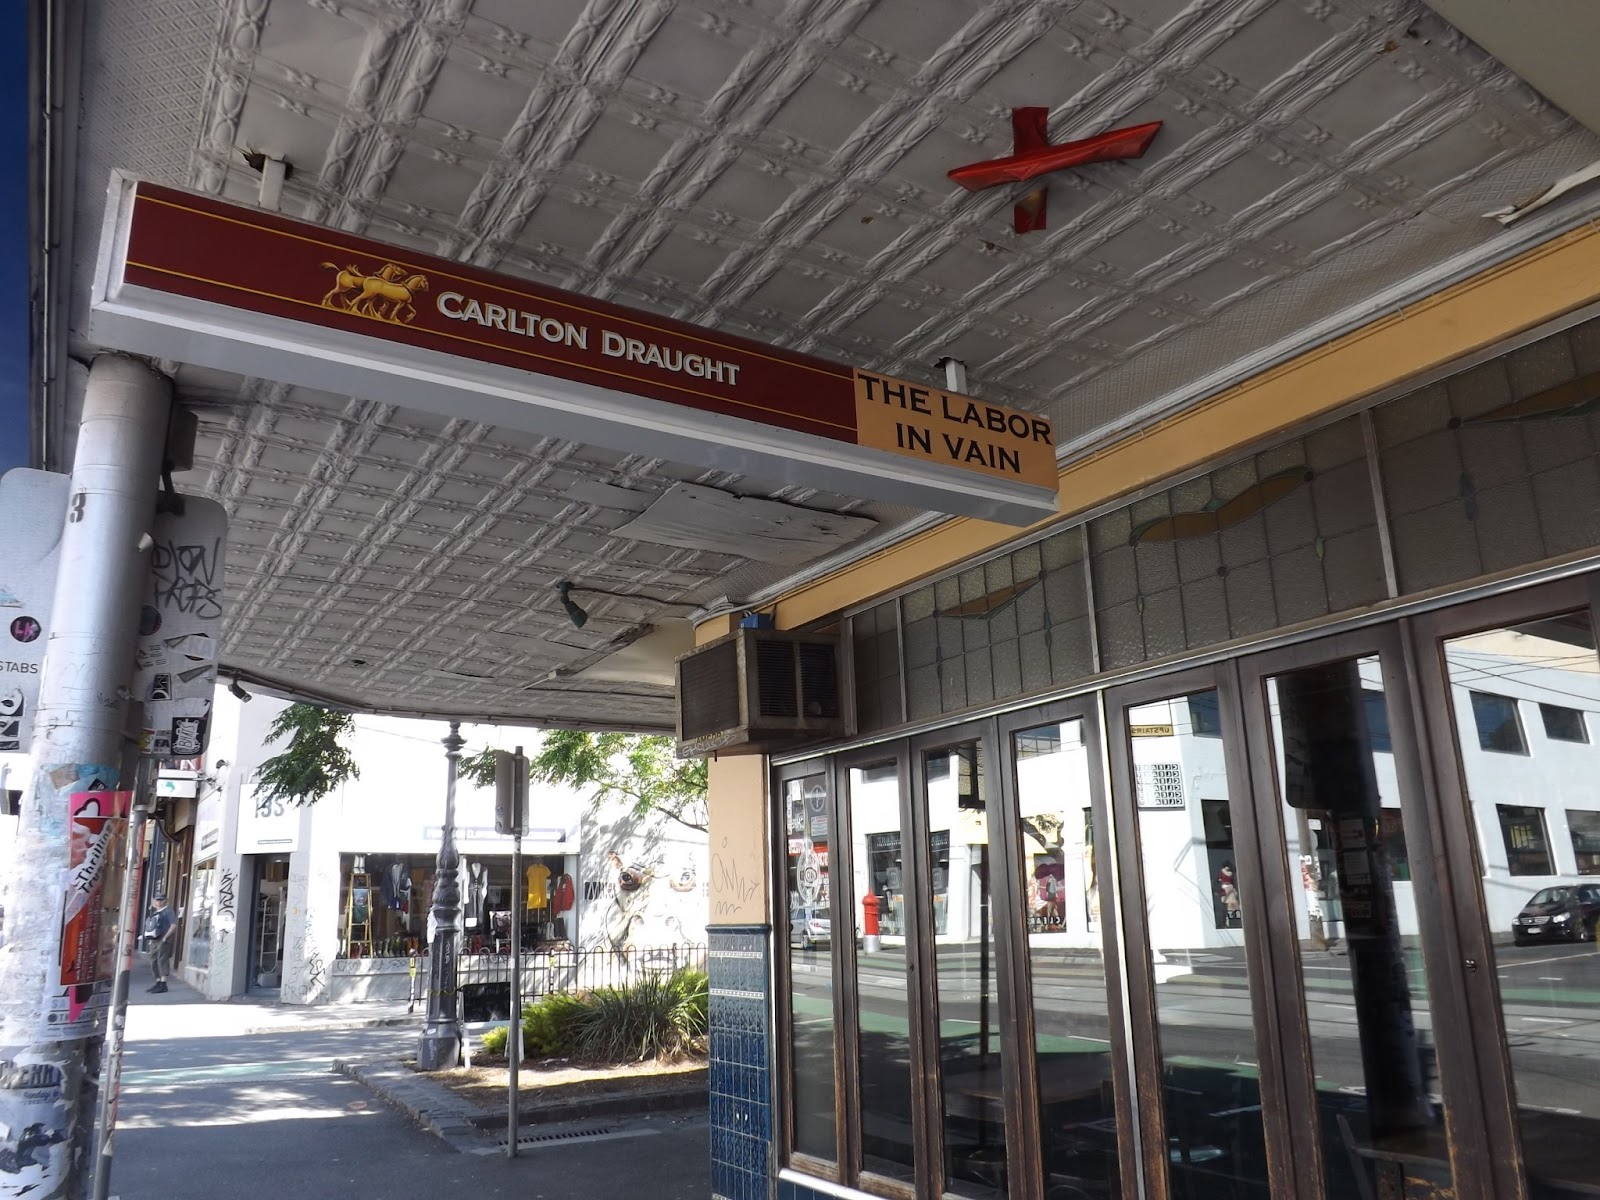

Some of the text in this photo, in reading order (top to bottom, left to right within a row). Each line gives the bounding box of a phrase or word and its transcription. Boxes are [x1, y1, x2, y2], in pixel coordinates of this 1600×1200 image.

[436, 291, 740, 386] CARLTON DRAUGHT
[857, 373, 1054, 446] THE LABOR
[896, 422, 1022, 474] IN VAIN
[70, 492, 87, 523] 3
